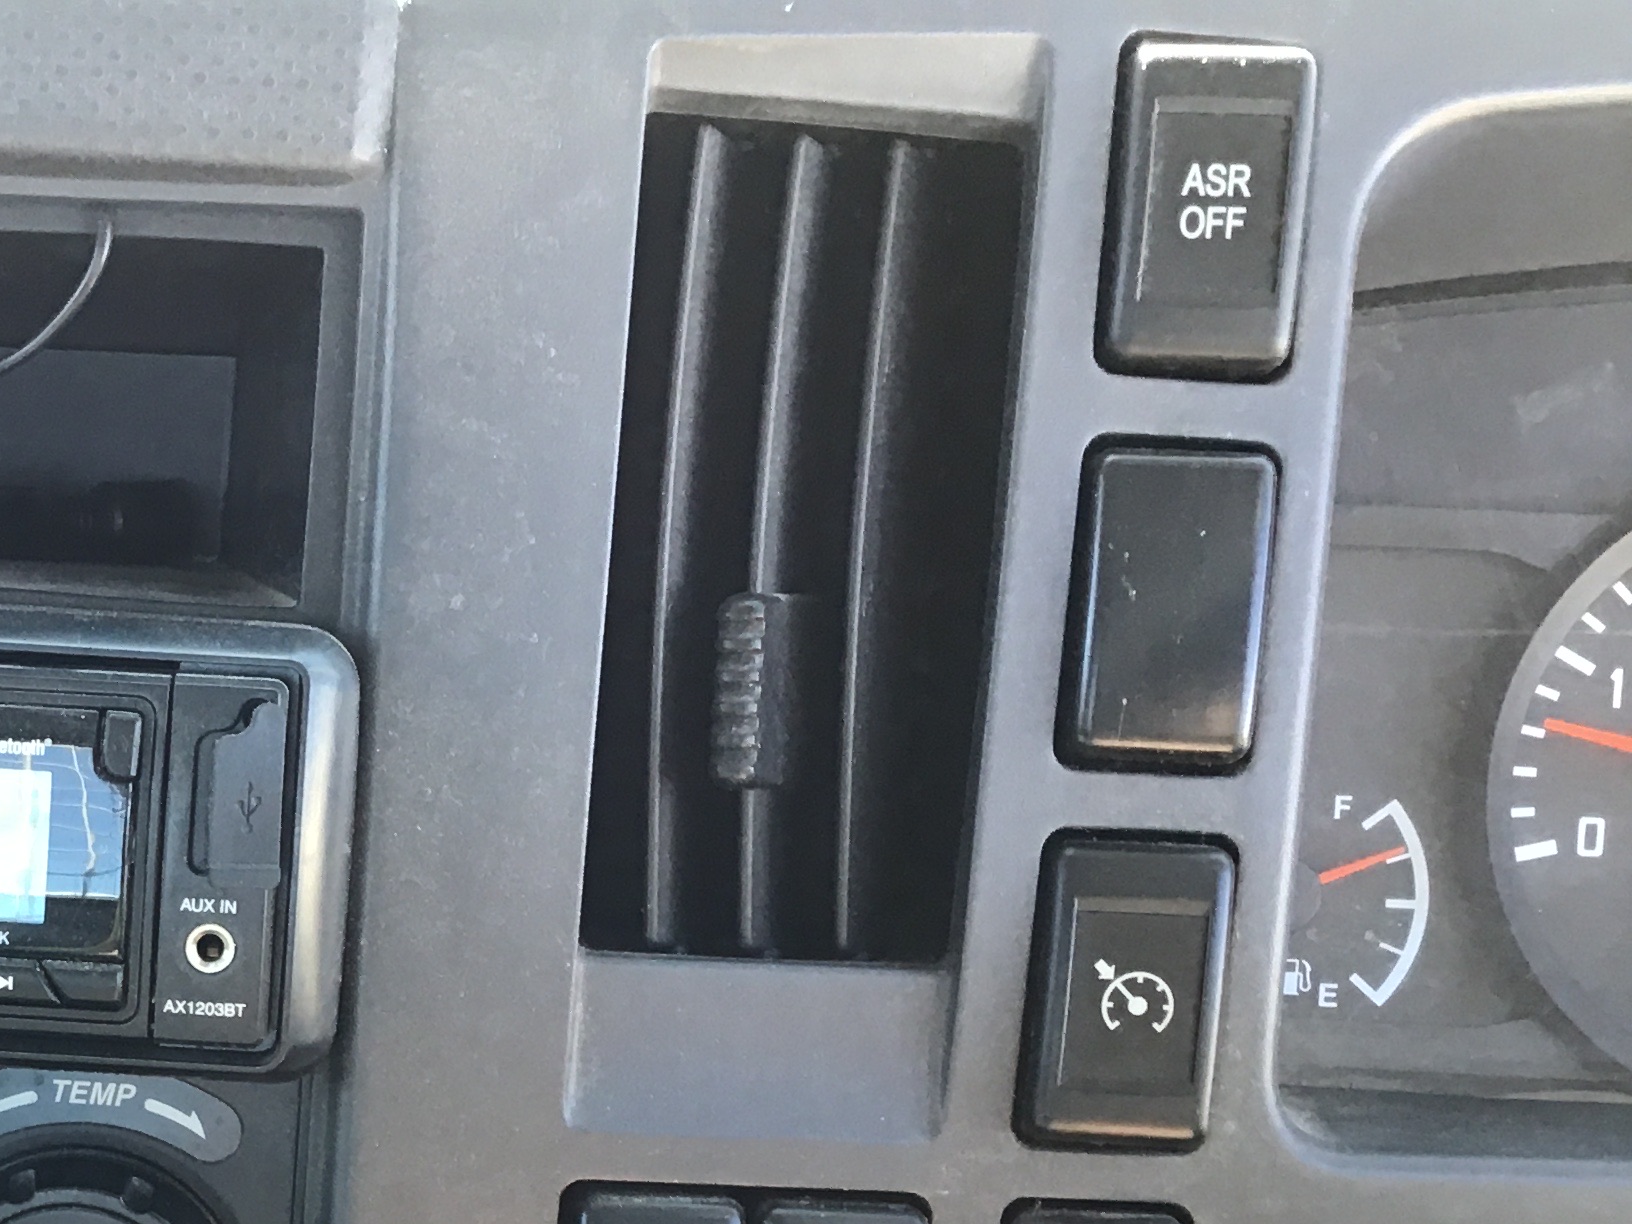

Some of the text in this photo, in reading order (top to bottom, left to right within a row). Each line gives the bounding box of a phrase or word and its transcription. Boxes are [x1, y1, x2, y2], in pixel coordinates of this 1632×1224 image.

[1180, 162, 1251, 198] ASR
[1179, 204, 1247, 240] OFF
[1609, 667, 1624, 709] 1
[1332, 794, 1353, 820] F
[1576, 816, 1606, 858] 0
[180, 897, 237, 915] AUX IN
[163, 999, 247, 1018] AX1203BT
[1318, 982, 1339, 1008] E
[52, 1078, 137, 1107] TEMP
